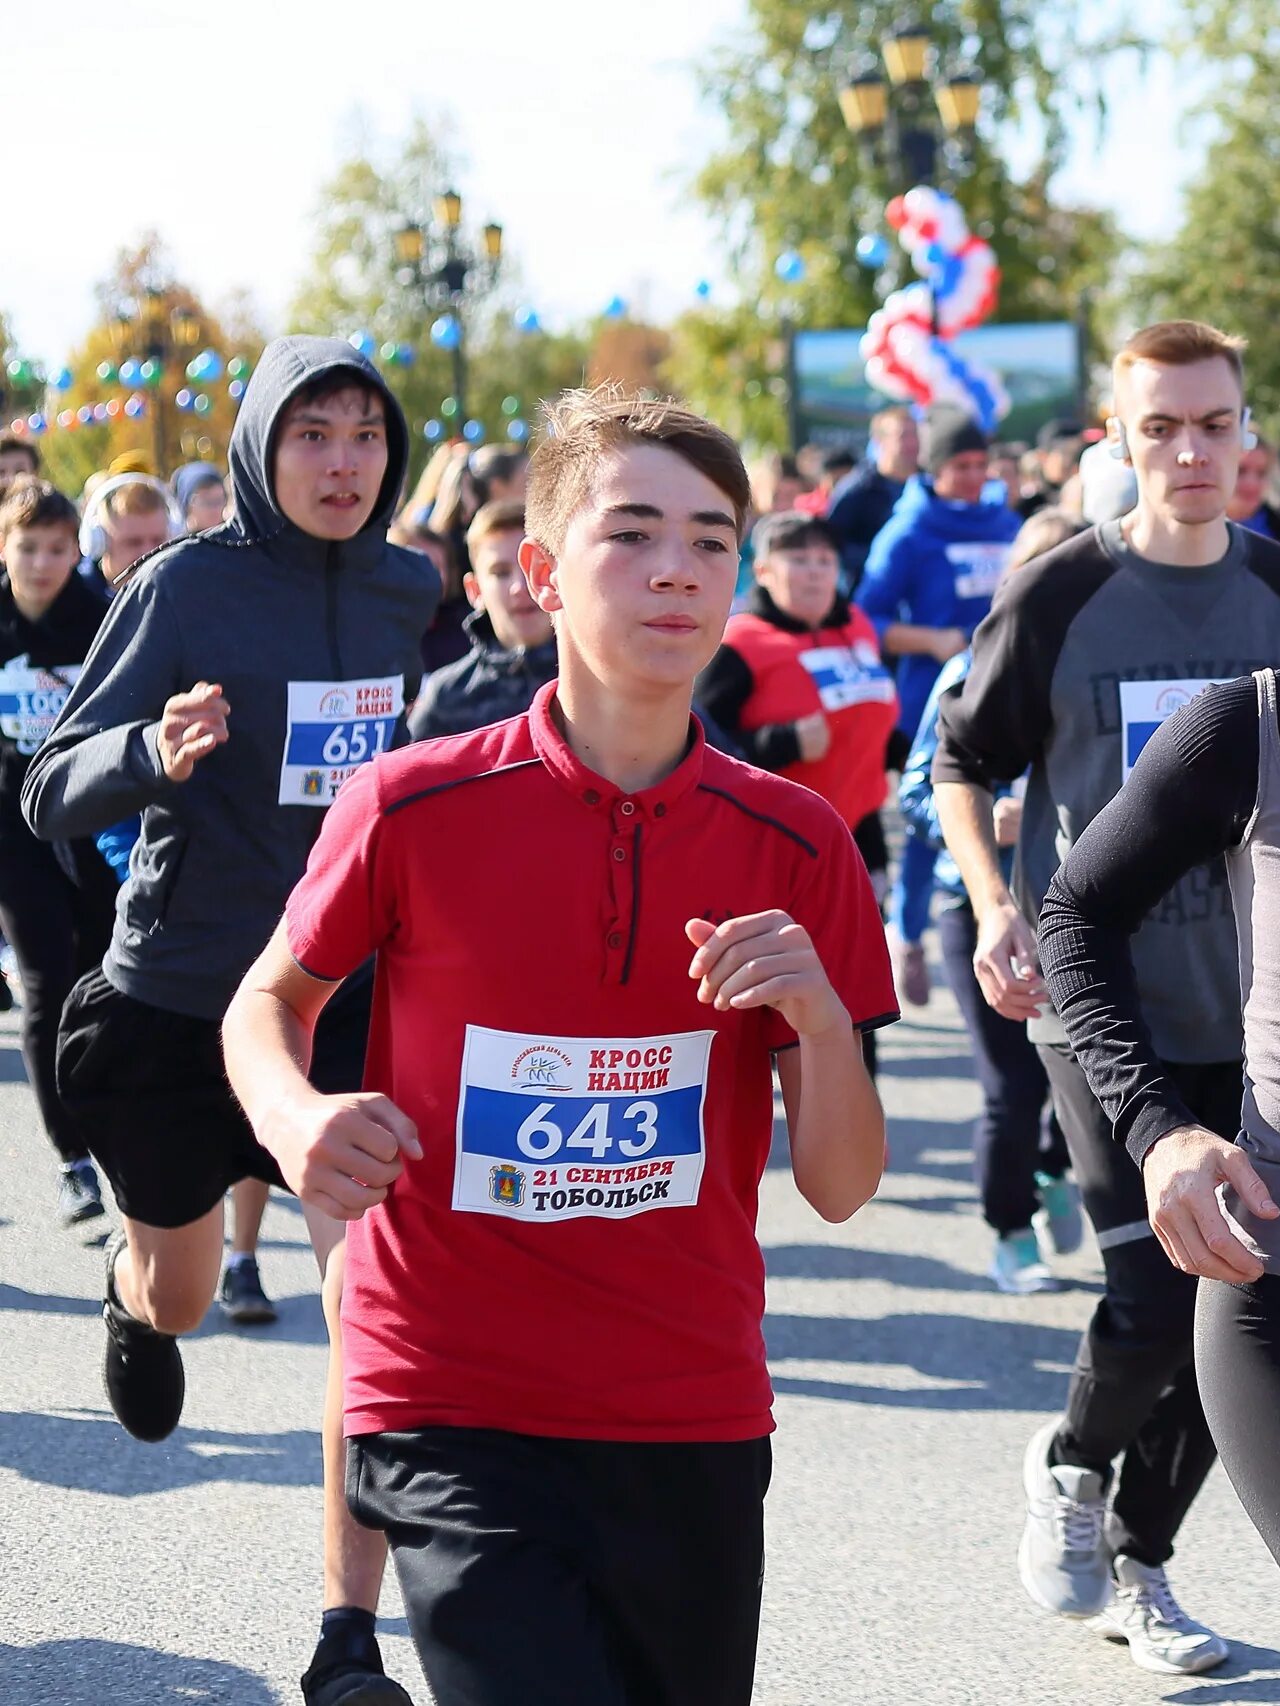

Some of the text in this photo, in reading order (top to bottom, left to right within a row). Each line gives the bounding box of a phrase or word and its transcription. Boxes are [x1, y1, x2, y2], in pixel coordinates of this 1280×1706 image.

[322, 720, 386, 765] 651
[589, 1045, 672, 1069] КРОСС
[587, 1068, 669, 1094] НАЦИИ
[517, 1100, 659, 1160] 643
[533, 1160, 675, 1186] 21 СЕНТЯБРЯ
[532, 1179, 670, 1212] ТОБОЛЬСК
